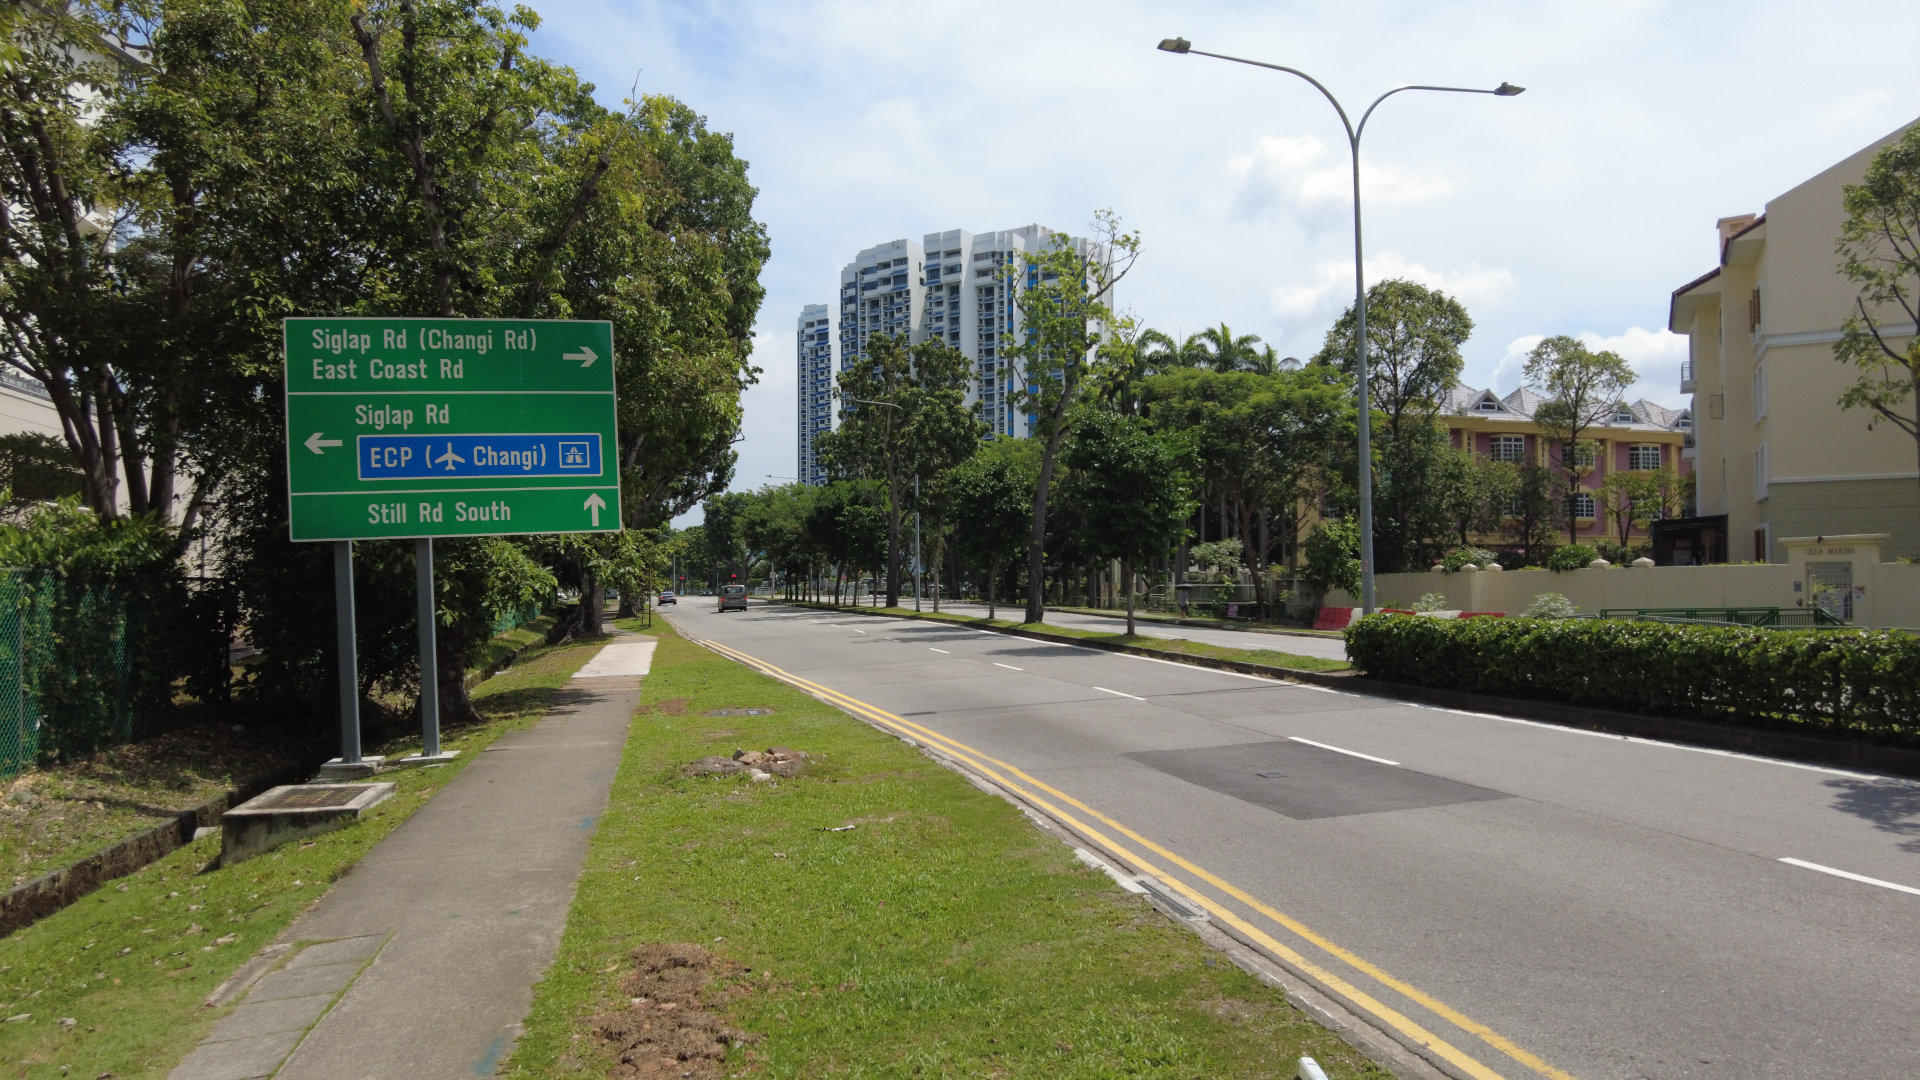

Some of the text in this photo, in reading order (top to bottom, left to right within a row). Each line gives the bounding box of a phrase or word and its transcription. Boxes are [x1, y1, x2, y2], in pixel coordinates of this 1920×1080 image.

[312, 327, 537, 355] Siglap Rd (Changi Rd)
[312, 358, 464, 380] East Coast Rd
[355, 403, 450, 430] Siglap Rd
[370, 446, 413, 468] ECP
[473, 443, 547, 471] Changi)
[367, 500, 511, 525] Still Rd South
